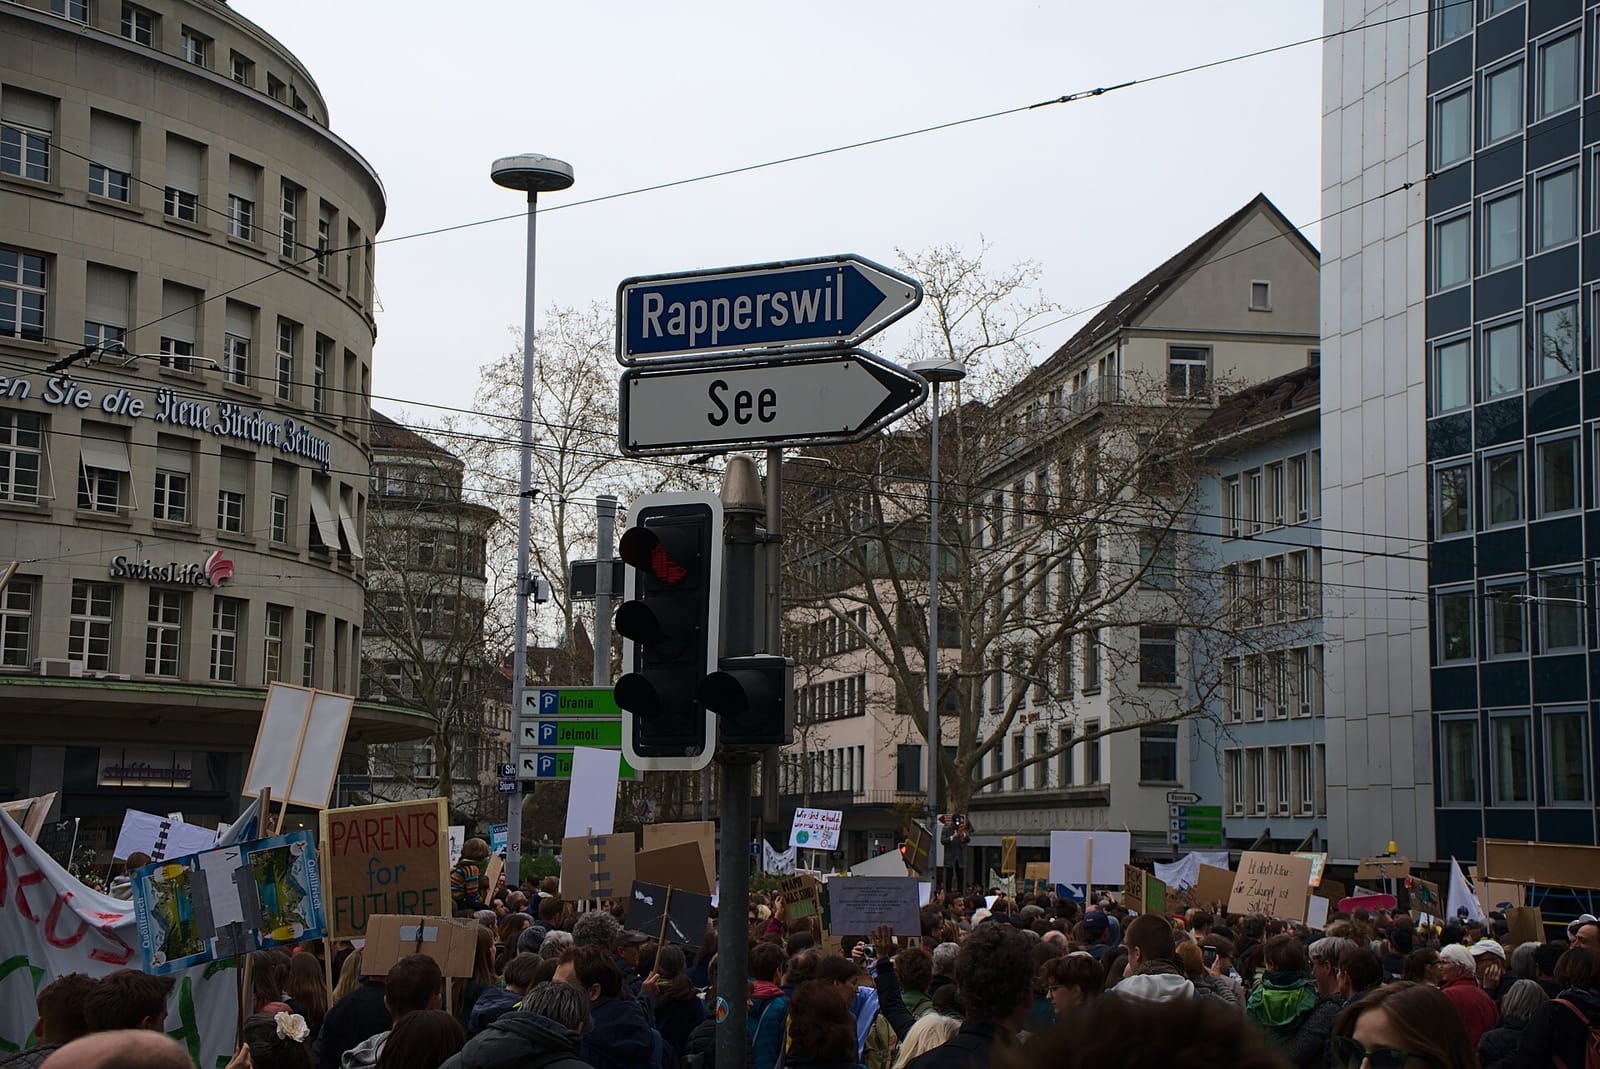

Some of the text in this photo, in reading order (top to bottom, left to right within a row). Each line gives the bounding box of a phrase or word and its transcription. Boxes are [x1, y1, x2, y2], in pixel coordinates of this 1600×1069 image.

[642, 272, 844, 347] Rapperswil
[707, 379, 777, 427] See
[0, 375, 333, 474] en Sie die Neue Zürcher Zeitung
[110, 555, 204, 586] SwissLife
[544, 696, 594, 709] P Urania
[543, 727, 599, 740] P Jelmoli
[542, 758, 573, 772] P Tal
[331, 812, 439, 857] PARENTS
[367, 855, 406, 892] for
[335, 888, 438, 932] FUTURE
[1279, 887, 1290, 899] ist
